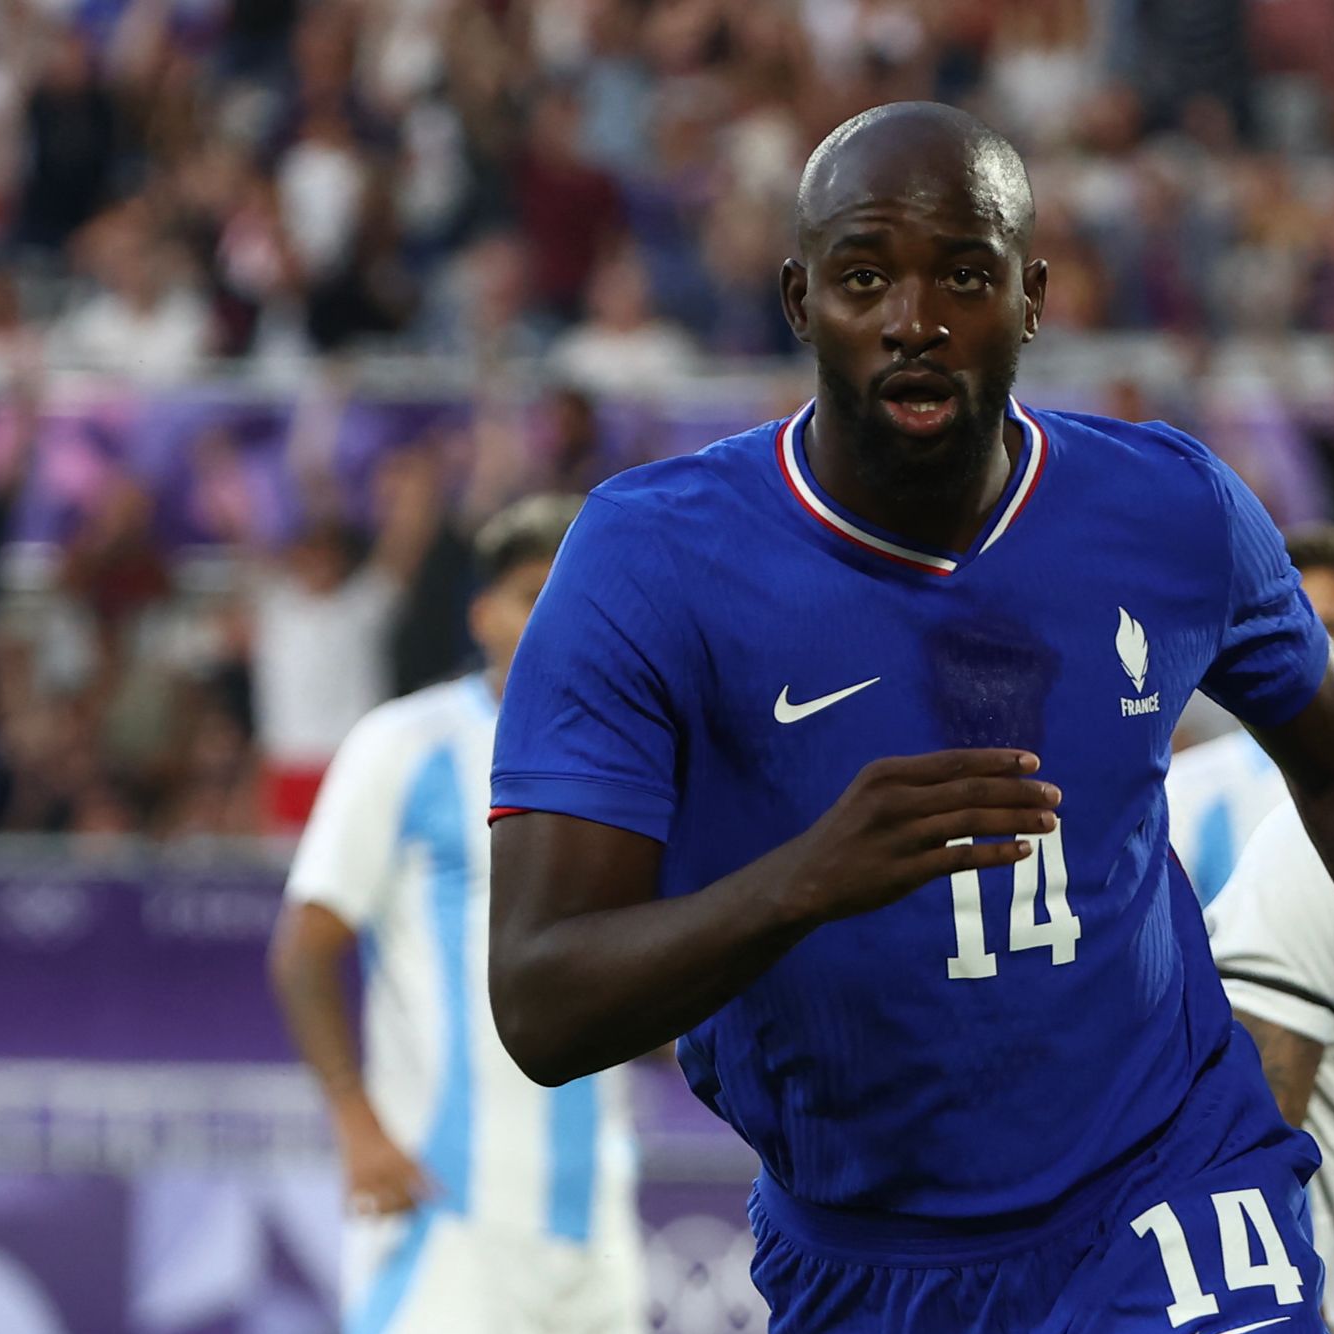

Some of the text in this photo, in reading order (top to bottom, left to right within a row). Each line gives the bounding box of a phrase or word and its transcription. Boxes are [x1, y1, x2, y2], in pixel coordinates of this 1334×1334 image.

[1120, 692, 1160, 717] FRANCE
[945, 818, 1081, 979] 14
[1129, 1188, 1304, 1329] 14
